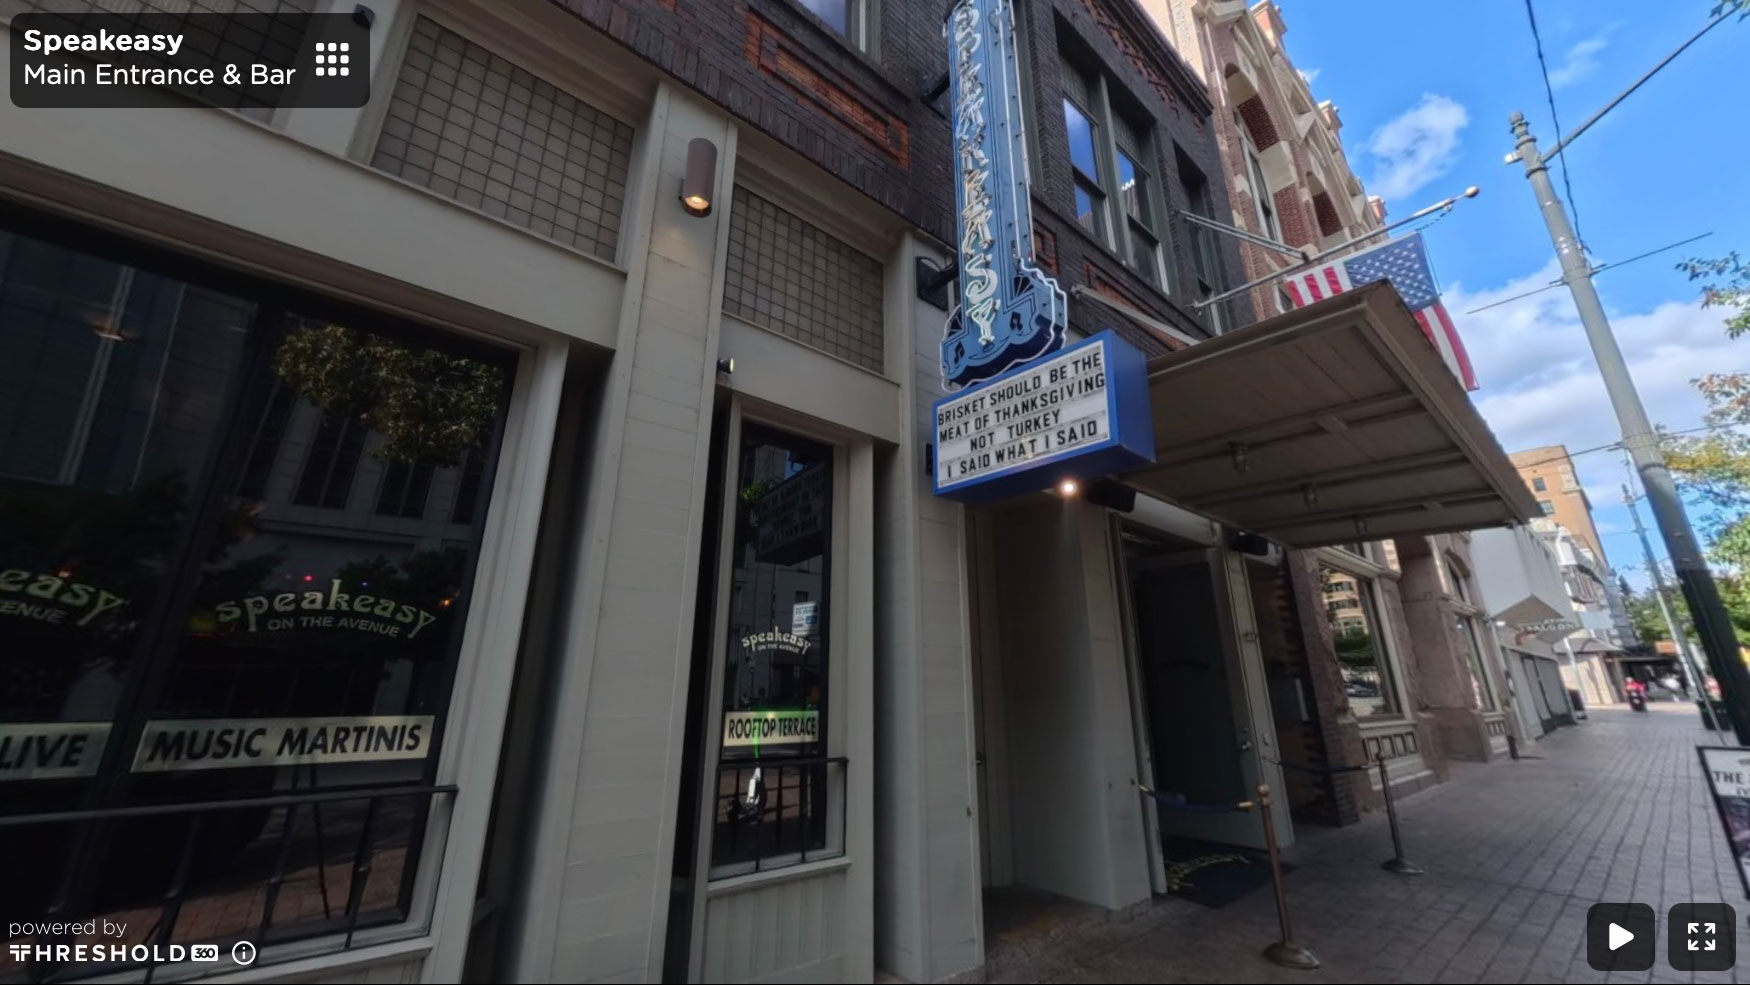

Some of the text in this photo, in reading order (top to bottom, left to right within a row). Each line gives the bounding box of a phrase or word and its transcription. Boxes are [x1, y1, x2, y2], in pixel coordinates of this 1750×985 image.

[938, 352, 1101, 426] BRISKET SHOULD BE THE
[939, 373, 1105, 443] MEAT OF THANKSGIVING
[947, 420, 1097, 478] I SAID WHAT I SAID
[970, 409, 1061, 451] NOT TURKEY
[215, 578, 436, 639] speakeasy
[267, 616, 401, 637] ON THE AVENUE
[742, 626, 811, 654] speakeasy
[147, 723, 422, 763] MUSIC MARTINIS
[728, 717, 816, 739] ROOFTOP TERRACE
[0, 734, 88, 768] LIVE
[1712, 771, 1744, 784] THE
